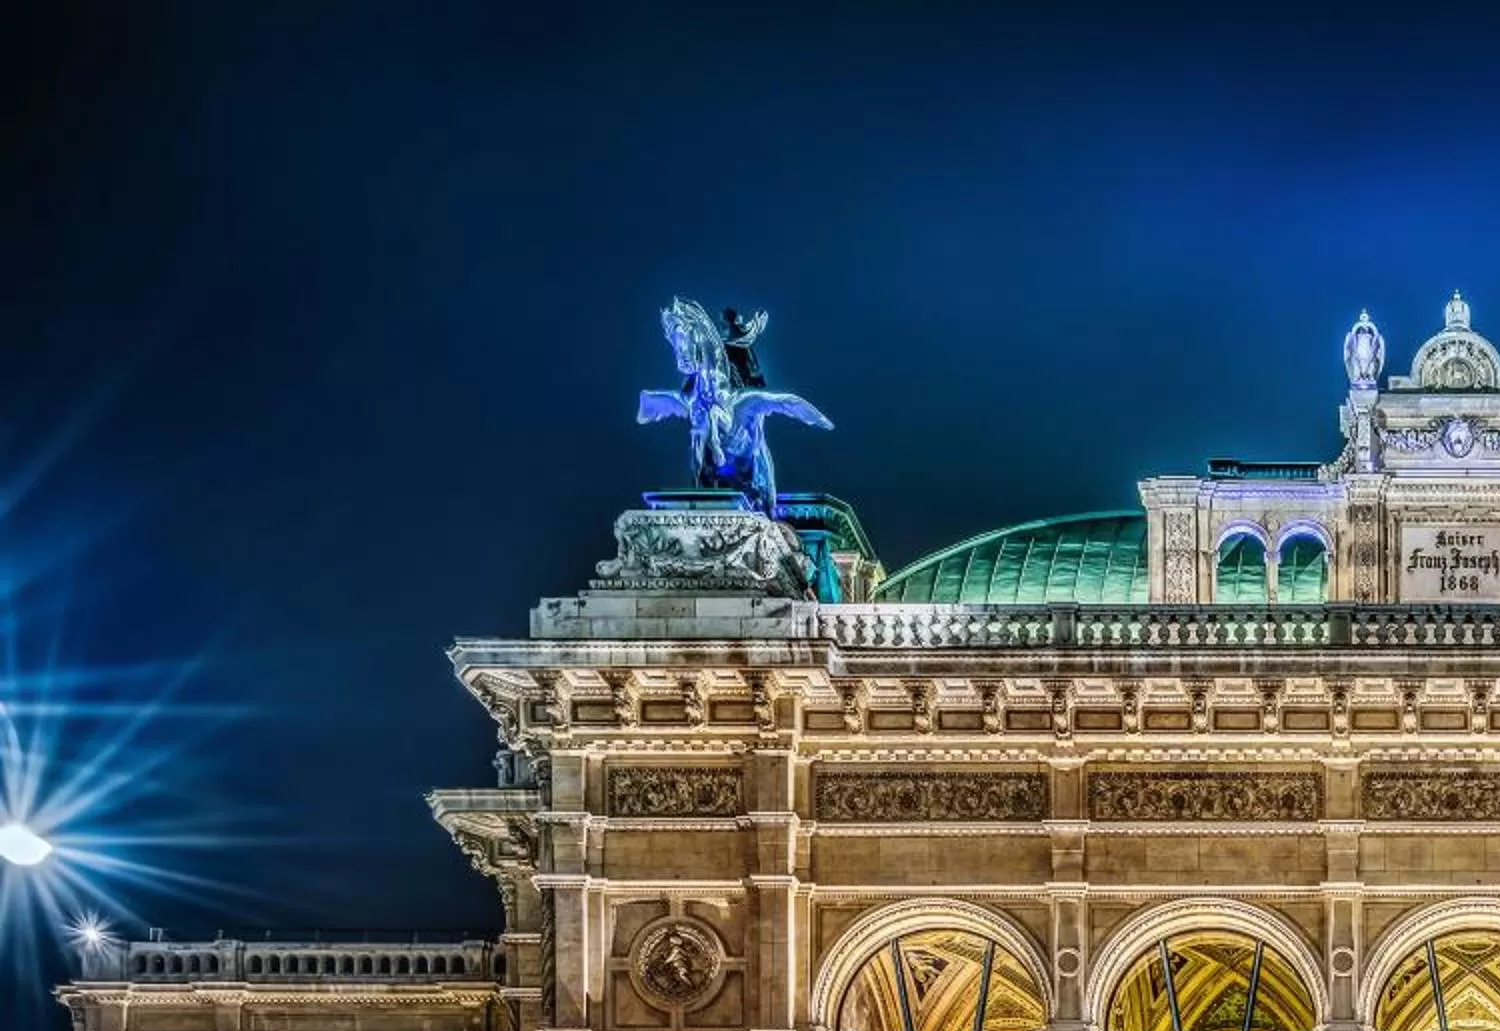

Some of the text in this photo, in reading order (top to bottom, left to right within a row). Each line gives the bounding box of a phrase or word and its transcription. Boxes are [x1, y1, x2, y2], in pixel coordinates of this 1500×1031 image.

[1435, 530, 1484, 548] Kaiser
[1407, 548, 1447, 575] Franz
[1449, 548, 1500, 576] Joseph
[1440, 575, 1479, 592] 1868
